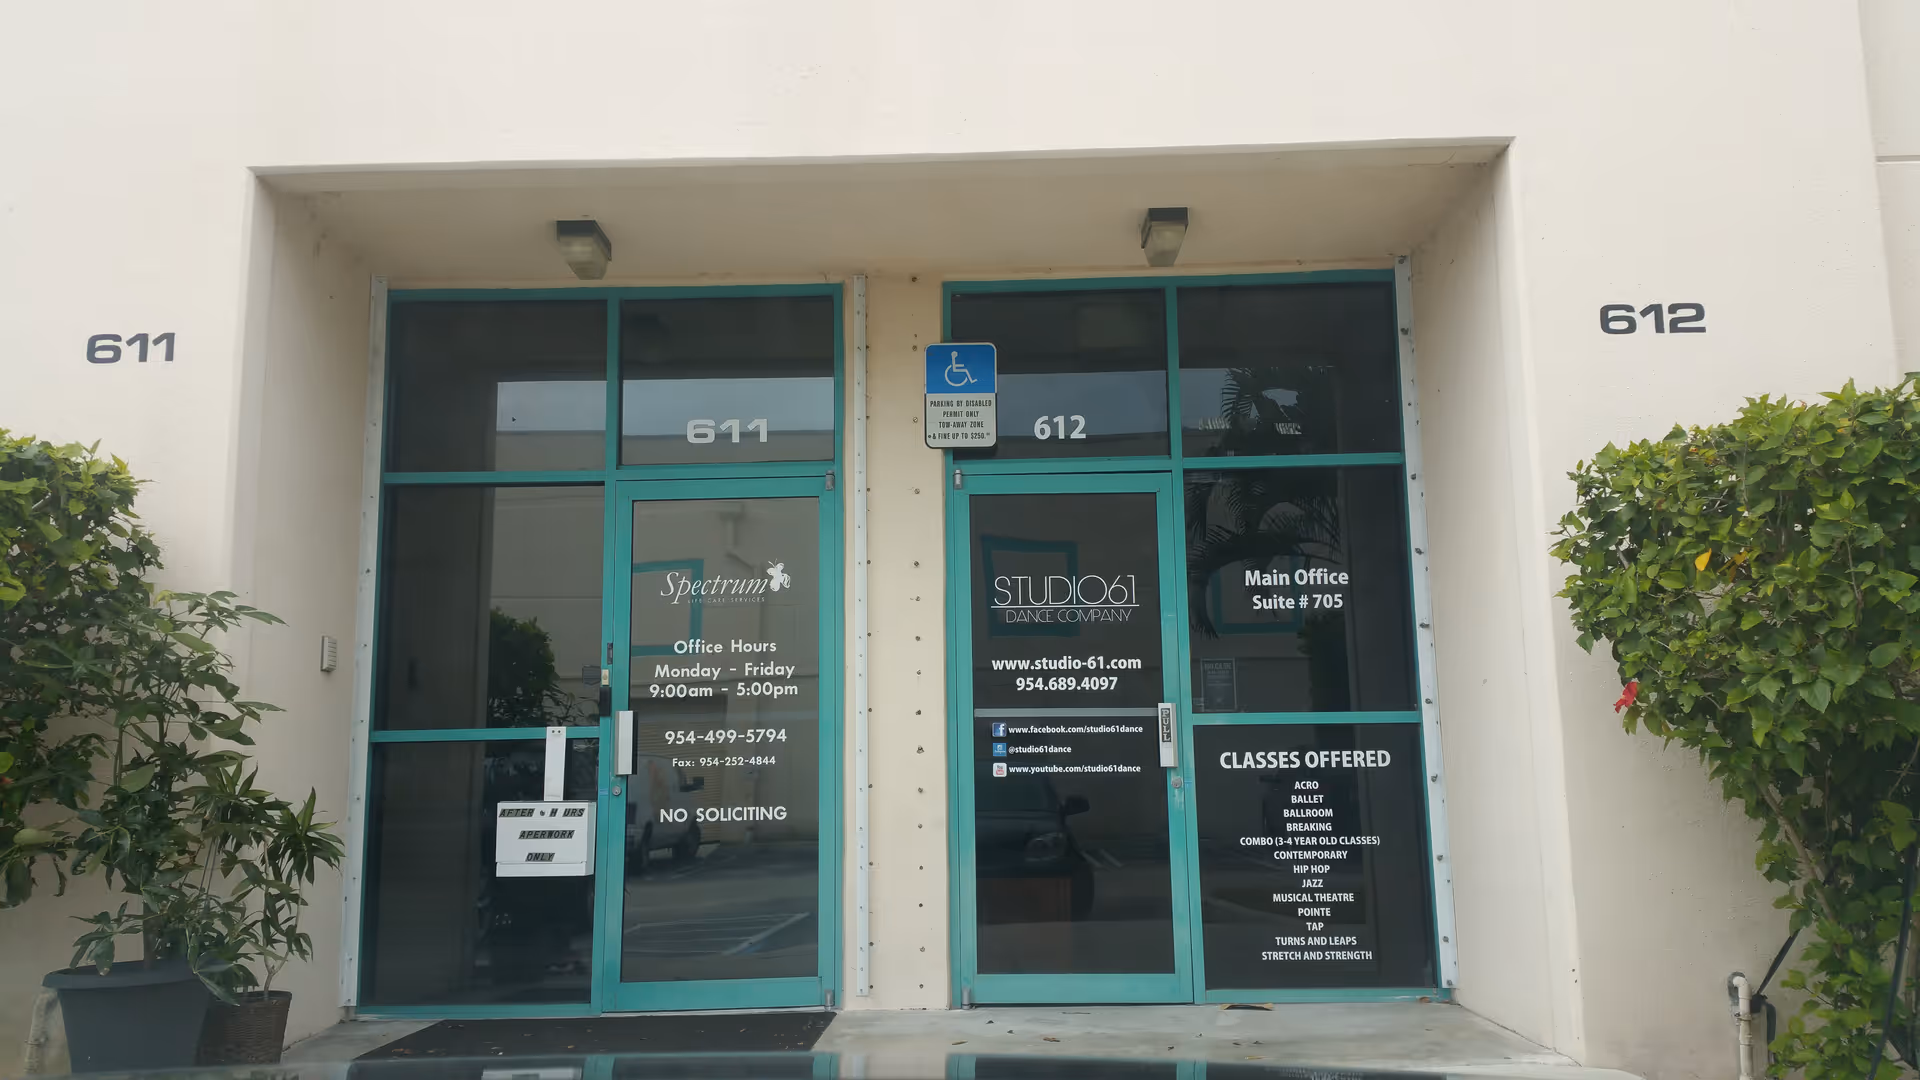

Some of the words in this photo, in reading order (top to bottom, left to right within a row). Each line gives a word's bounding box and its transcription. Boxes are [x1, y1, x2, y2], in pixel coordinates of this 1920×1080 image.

[1599, 302, 1707, 335] 612
[86, 332, 176, 364] 611
[965, 399, 992, 407] DISABLED
[938, 421, 967, 429] TOW-AWAY
[1034, 414, 1087, 440] 612
[686, 418, 768, 444] 611
[1245, 569, 1290, 586] Main
[1294, 568, 1349, 585] Office
[660, 571, 769, 605] Spectrum
[994, 575, 1136, 605] STUDIO61
[1252, 594, 1296, 610] Suite
[1298, 594, 1309, 609] #
[1312, 593, 1344, 609] 705
[1006, 609, 1054, 623] DANCE
[1057, 608, 1133, 623] COMPANY
[673, 640, 724, 654] Office
[731, 639, 777, 653] Hours
[991, 656, 1142, 670] www.studio-61.com
[654, 664, 722, 680] Monday
[744, 661, 796, 678] Friday
[1016, 676, 1118, 691] 954.689.4097
[649, 684, 713, 698] 9:00am
[736, 682, 799, 699] 5:00pm
[1008, 725, 1144, 735] www.facebook.com/studio61dance
[1161, 709, 1171, 741] PULL
[664, 729, 788, 744] 954-499-5794
[1008, 744, 1072, 754] @studio61dance
[672, 758, 695, 767] Fax:
[699, 756, 776, 767] 954-252-4844
[1219, 751, 1301, 769] CLASSES
[1304, 750, 1391, 768] OFFERED
[1009, 765, 1141, 774] www.youtube.com/studio61dance
[1294, 781, 1319, 790] ACRO
[1291, 795, 1324, 804] BALLET
[499, 808, 535, 817] AFTER
[659, 808, 689, 823] NO
[695, 806, 788, 822] SOLICITING
[1283, 809, 1334, 818] BALLROOM
[1286, 823, 1333, 832] BREAKING
[1239, 837, 1274, 846] COMBO
[1275, 837, 1293, 846] (3-4
[1294, 837, 1318, 846] YEAR
[1319, 836, 1338, 846] OLD
[1339, 836, 1381, 846] CLASSES)
[526, 853, 554, 862] ONLY
[1273, 850, 1348, 860] CONTEMPORARY
[1293, 865, 1309, 874] HIP
[1310, 865, 1331, 874] HOP
[1301, 879, 1324, 888] JAZZ
[1272, 893, 1314, 902] MUSICAL
[1314, 893, 1354, 902] THEATRE
[1297, 907, 1331, 917] POINTE
[1306, 922, 1324, 931] TAP
[1275, 936, 1306, 946] TURNS
[1307, 936, 1328, 946] AND
[1329, 936, 1357, 946] LEAPS
[1261, 951, 1301, 961] STRETCH
[1303, 951, 1323, 961] AND
[1324, 950, 1373, 960] STRENGTH
